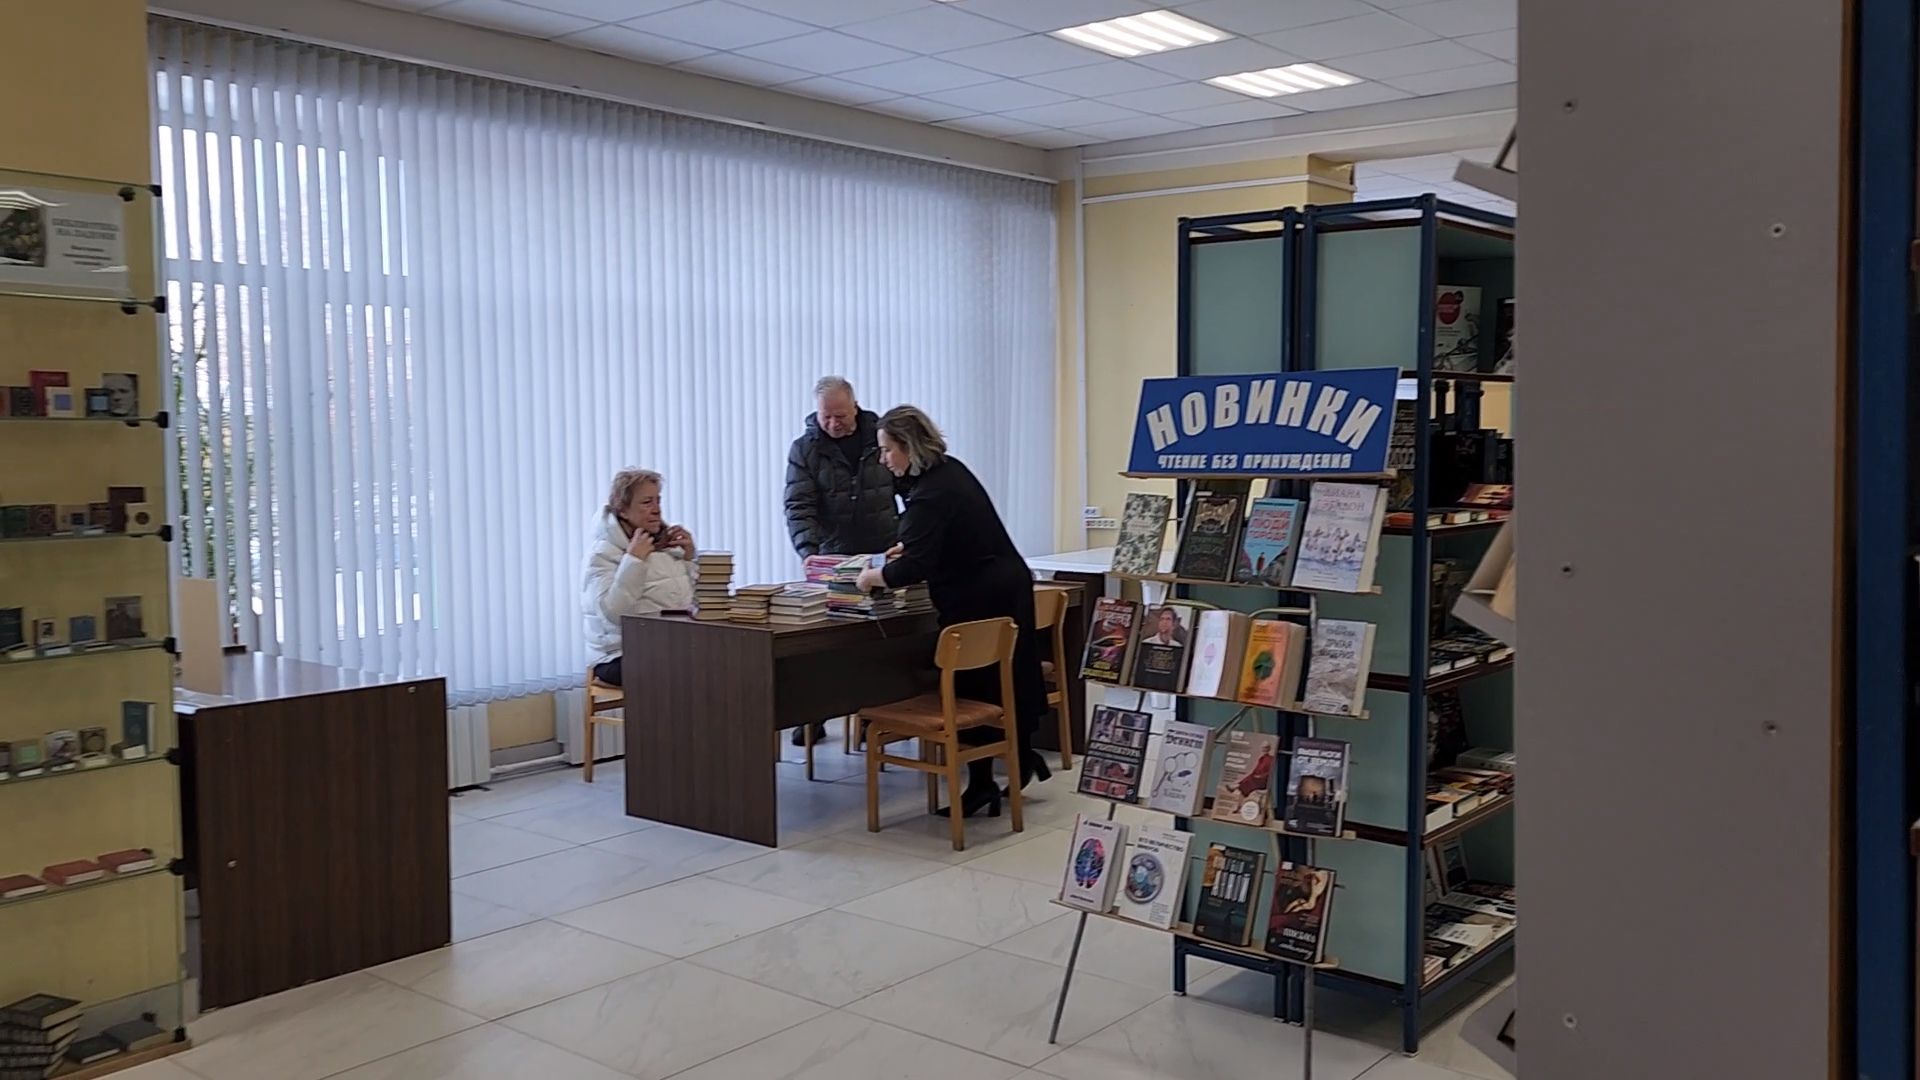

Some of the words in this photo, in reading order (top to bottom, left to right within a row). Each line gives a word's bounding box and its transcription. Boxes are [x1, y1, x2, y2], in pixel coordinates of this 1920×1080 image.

[1146, 379, 1383, 452] НОВИНКИ
[1157, 454, 1208, 470] ЧТЕНИЕ
[1211, 454, 1238, 470] БЕЗ
[1242, 453, 1352, 471] ПРИНУЖДЕНИЯ
[1250, 518, 1290, 530] ЛЮДИ
